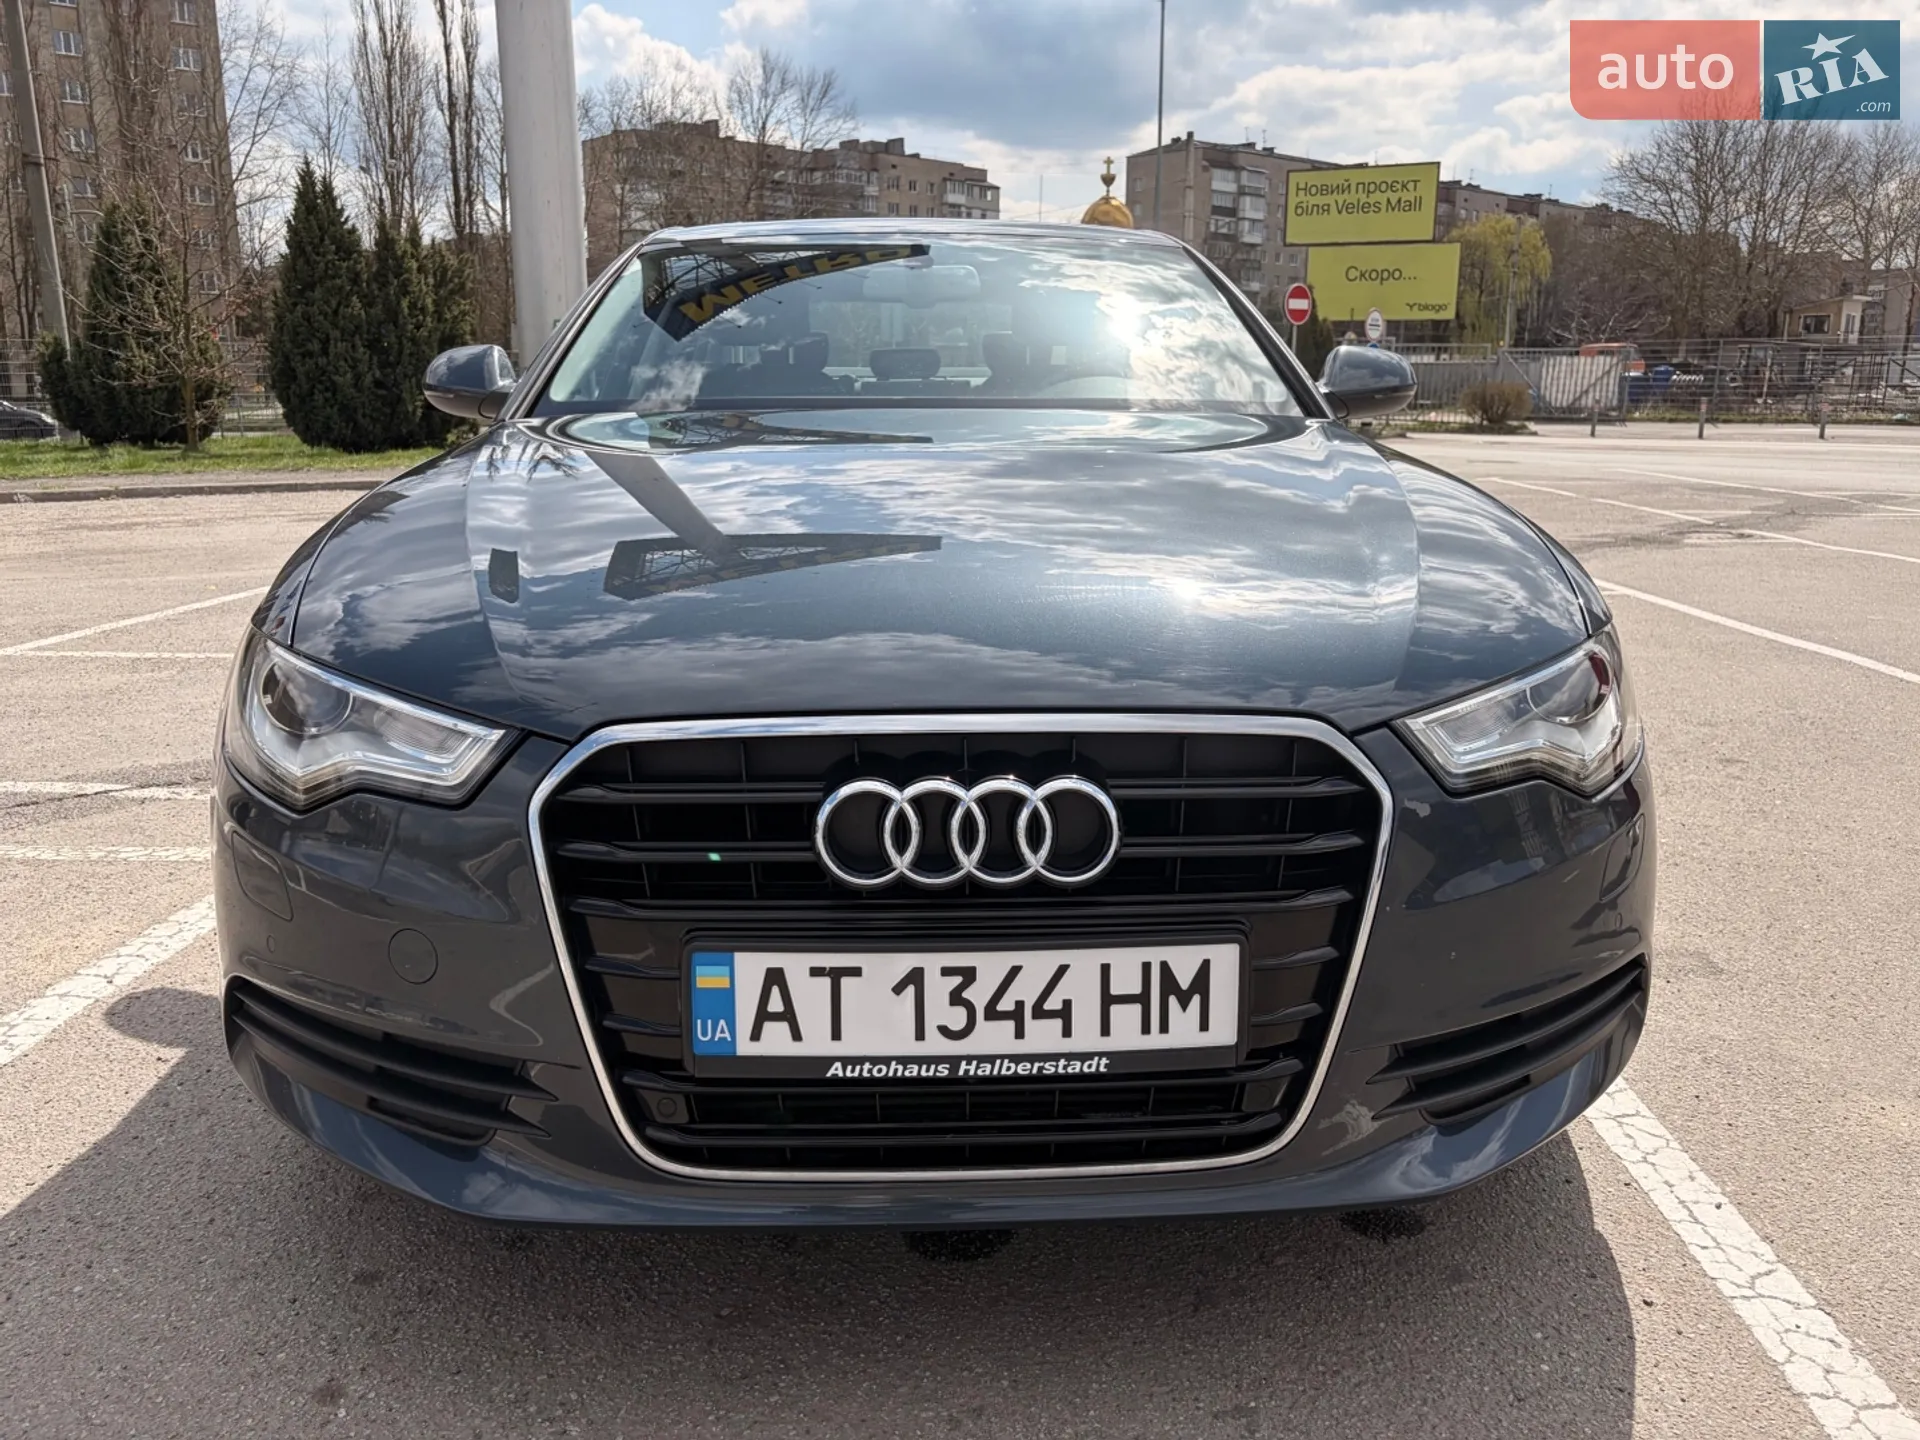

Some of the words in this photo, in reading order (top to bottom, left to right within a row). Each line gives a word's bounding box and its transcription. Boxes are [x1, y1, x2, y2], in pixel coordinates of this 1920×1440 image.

[1295, 178, 1351, 197] Новий
[1355, 178, 1421, 199] проєкт
[1294, 200, 1330, 217] біля
[1334, 198, 1382, 215] Veles
[1385, 195, 1422, 213] Mall
[749, 966, 863, 1042] AT
[891, 963, 1073, 1042] 1344
[1100, 958, 1211, 1038] HM
[696, 1018, 732, 1042] UA
[826, 1060, 950, 1078] Autohaus
[958, 1056, 1110, 1076] Halberstadt
